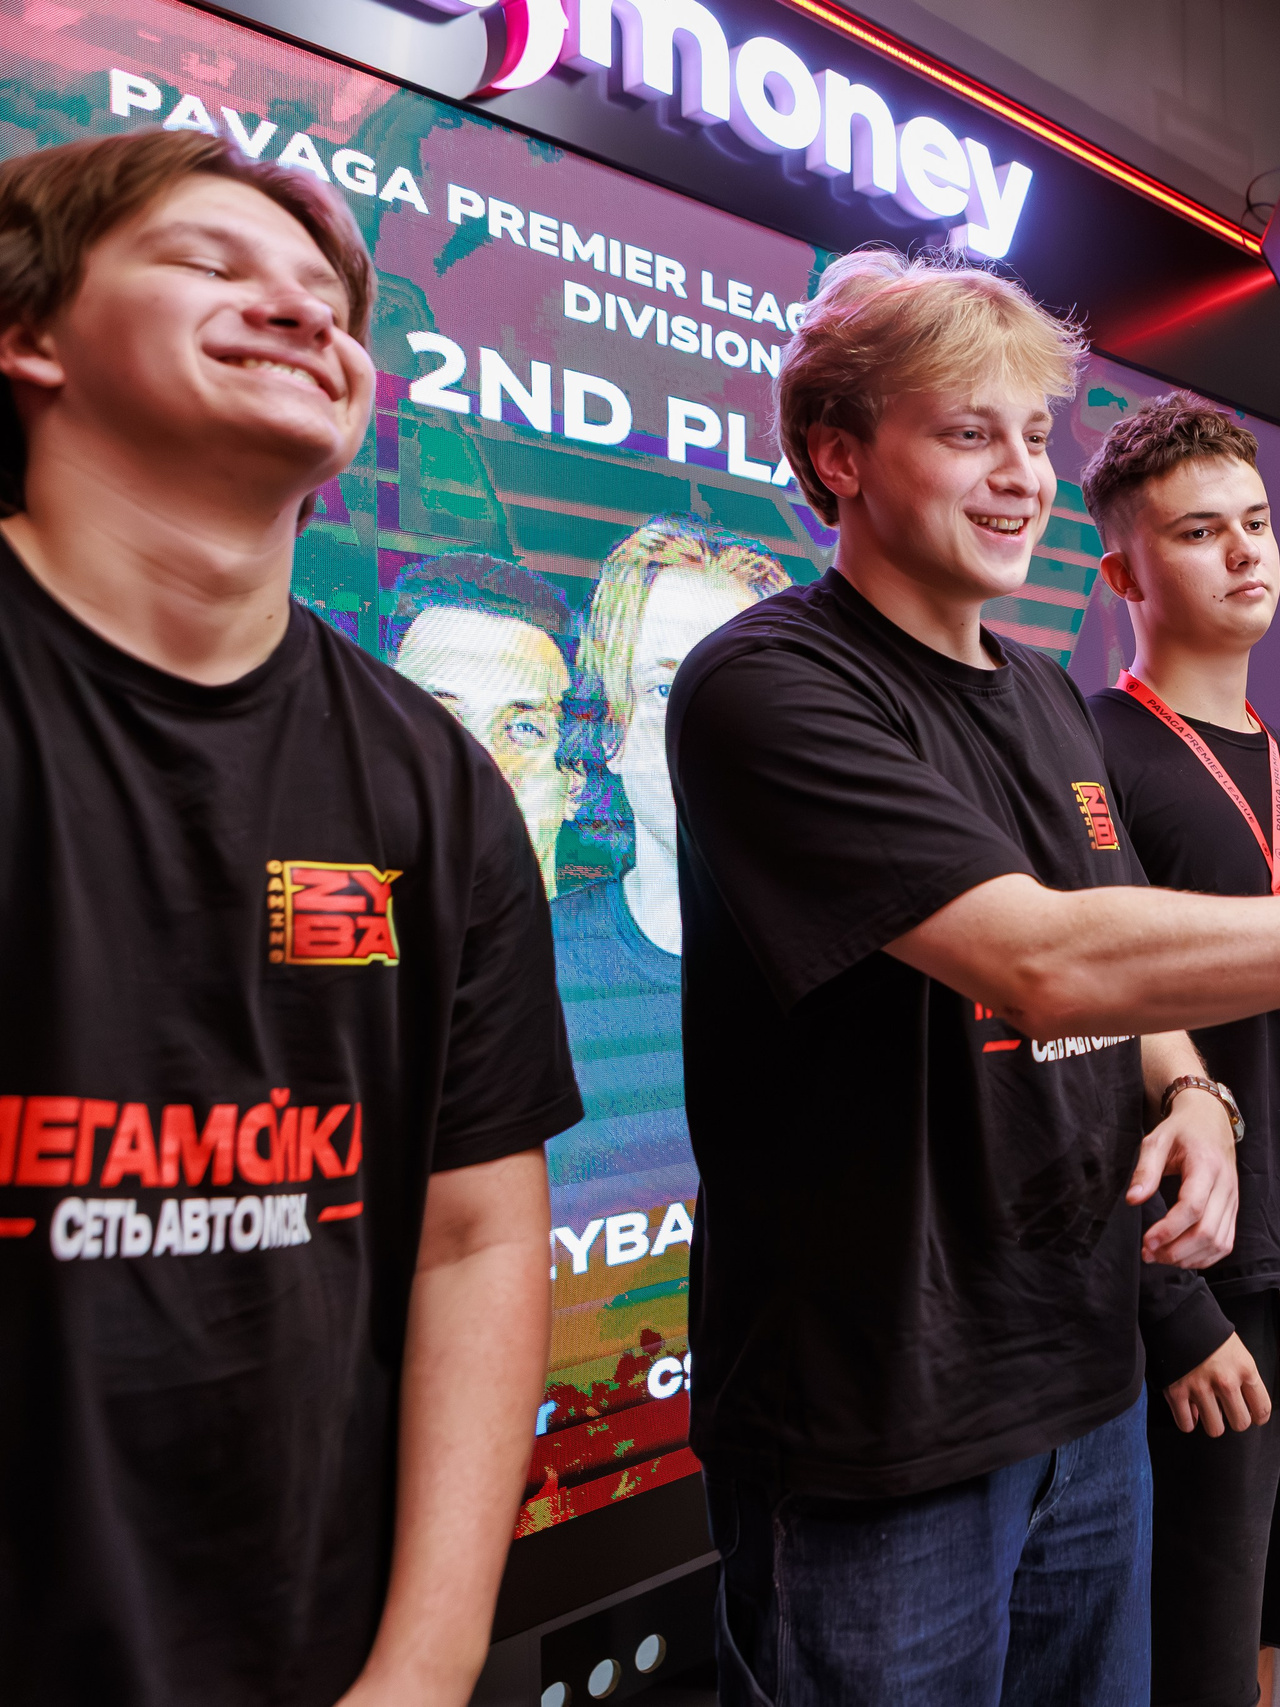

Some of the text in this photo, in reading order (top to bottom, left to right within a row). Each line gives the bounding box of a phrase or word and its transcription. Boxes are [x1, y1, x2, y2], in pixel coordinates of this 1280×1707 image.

[574, 0, 1034, 259] money
[110, 67, 430, 215] PAVAGA
[447, 183, 688, 299] PREMIER
[406, 329, 798, 487] 2ND PL
[1147, 699, 1255, 824] PAVAGA PREMIER LEAGUE
[291, 866, 392, 914] ZY
[292, 914, 398, 959] BA
[0, 1088, 363, 1188] ЕГАМОЙК
[51, 1197, 153, 1261] СЕТЬ
[549, 1202, 694, 1280] YBA
